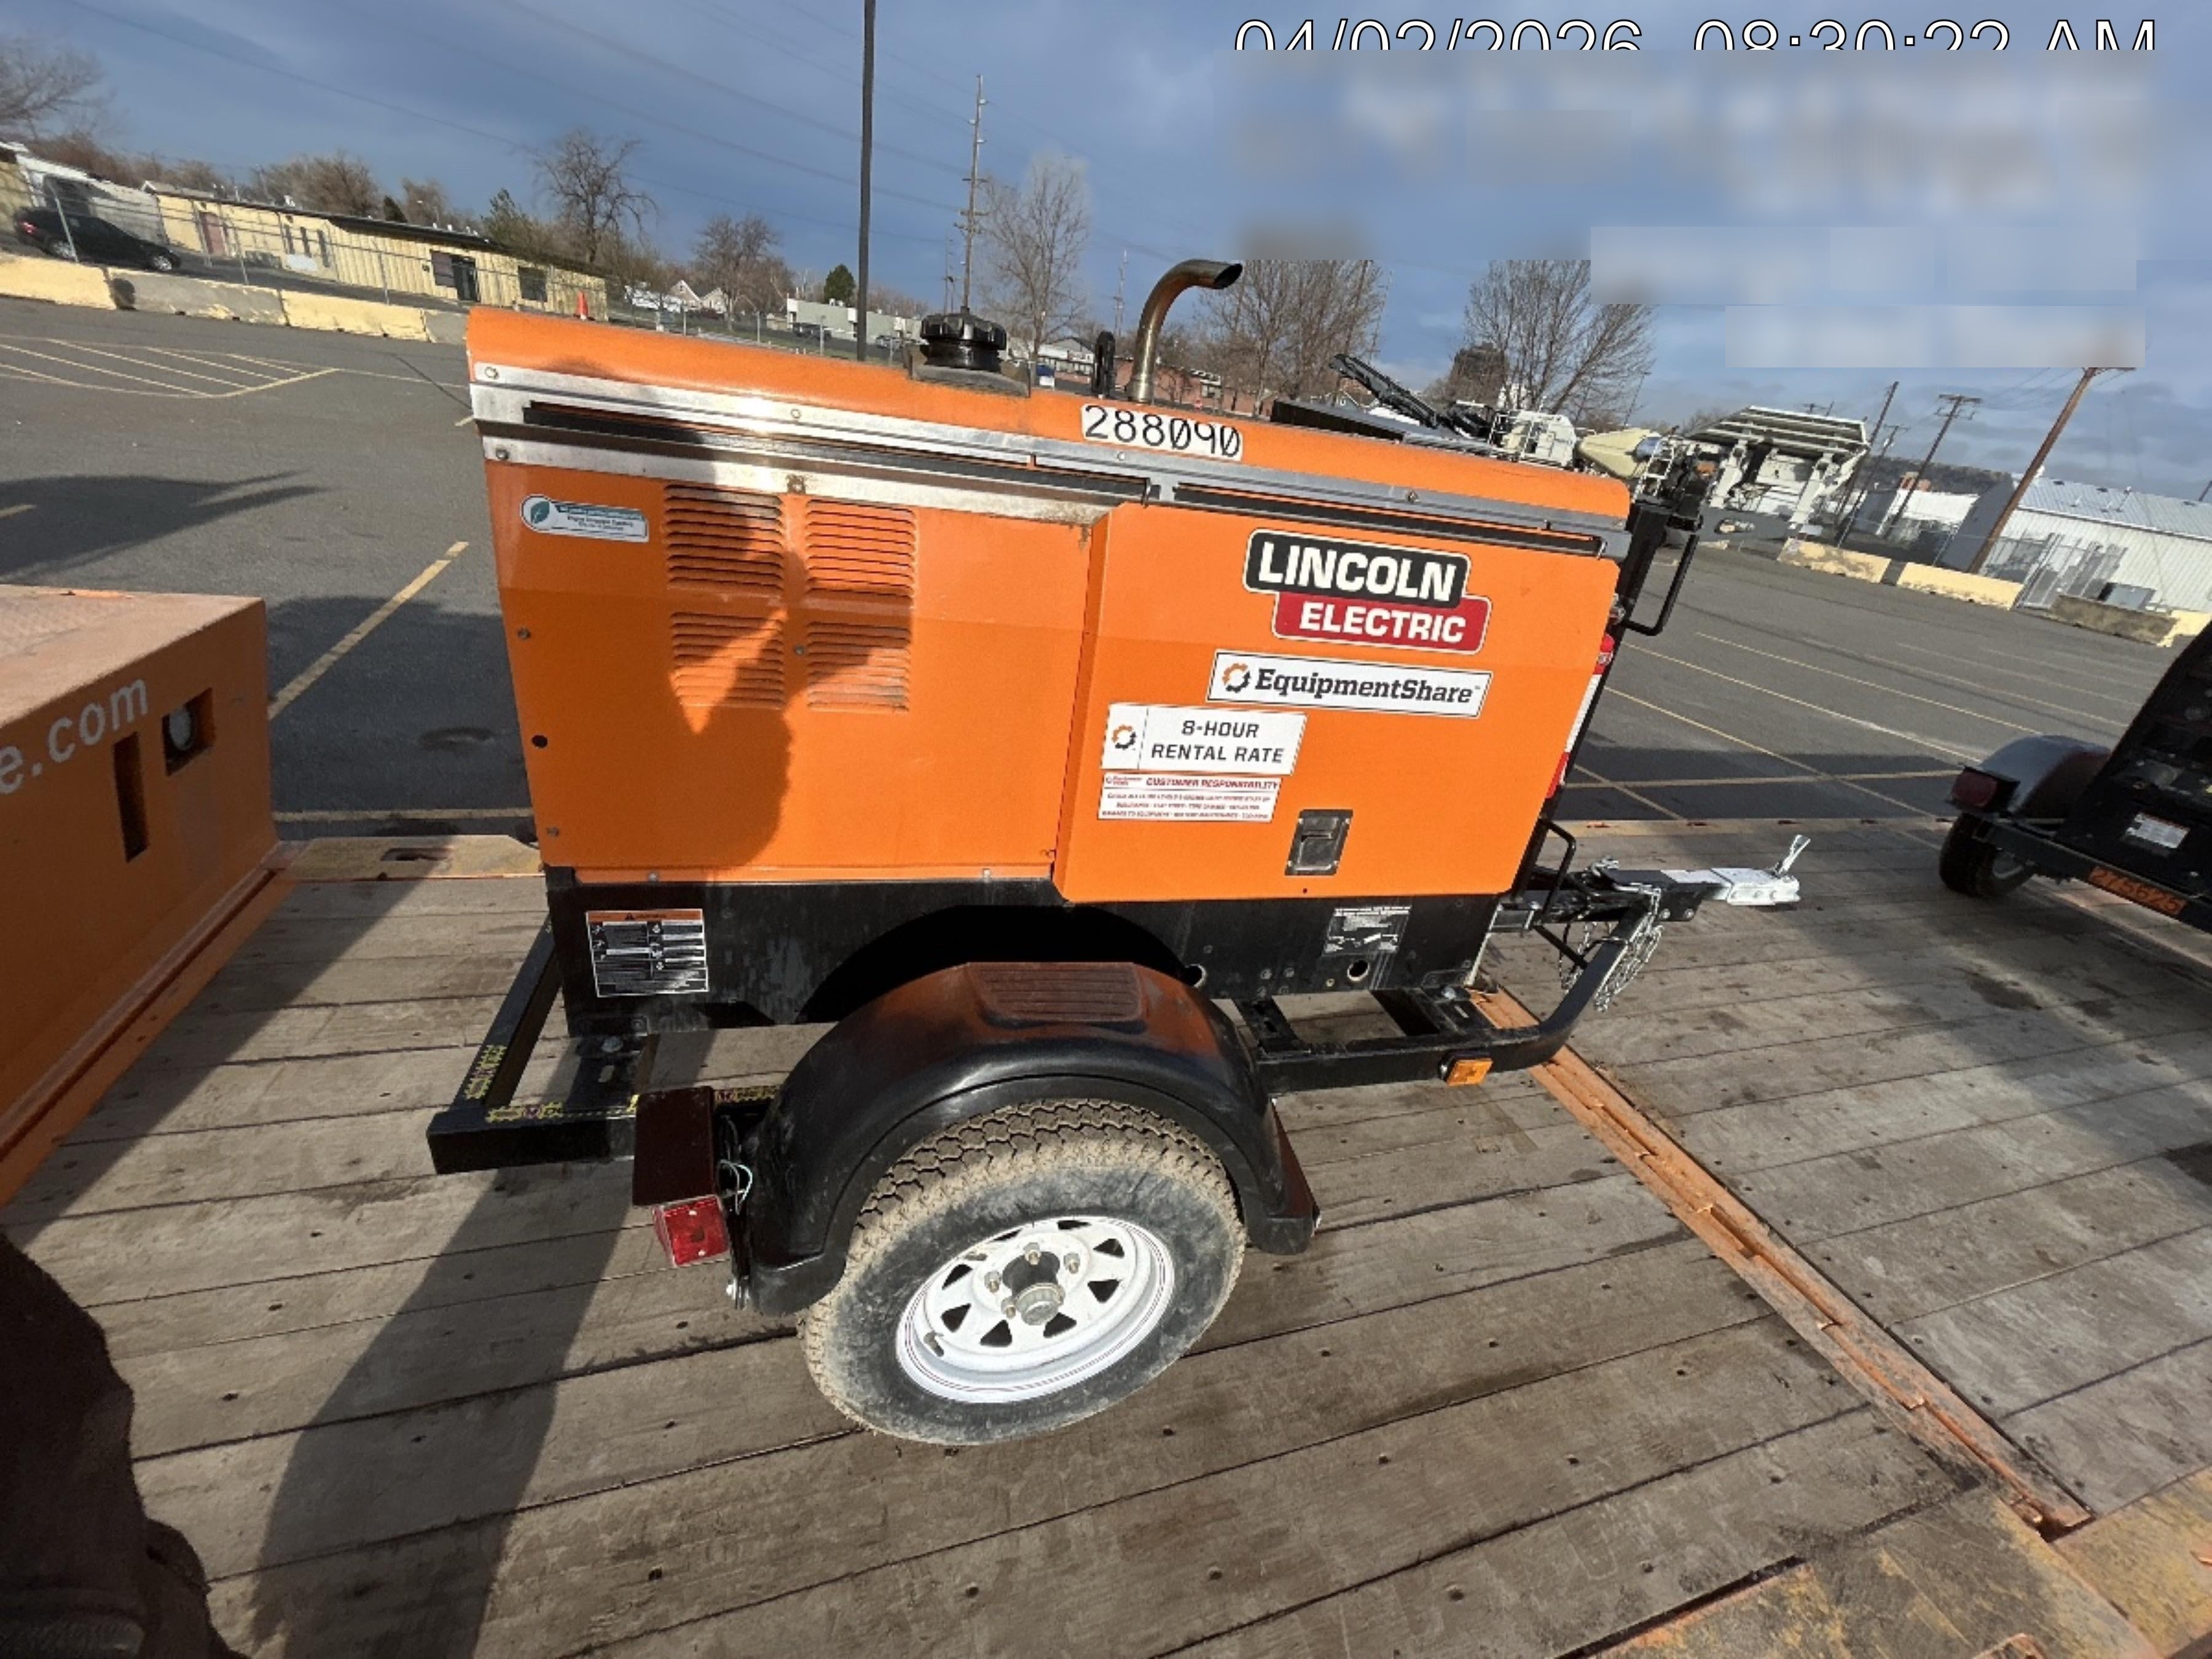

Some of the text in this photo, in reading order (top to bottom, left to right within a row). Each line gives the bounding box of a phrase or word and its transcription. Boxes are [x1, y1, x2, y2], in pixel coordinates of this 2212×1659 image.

[1086, 406, 1240, 457] 288090
[1258, 542, 1456, 601] LINCOLN
[1300, 602, 1466, 643] ELECTRIC
[1255, 669, 1473, 704] EquipmentShare
[1182, 720, 1260, 738] 8-HOUR
[1151, 744, 1284, 764] RENTAL RATE
